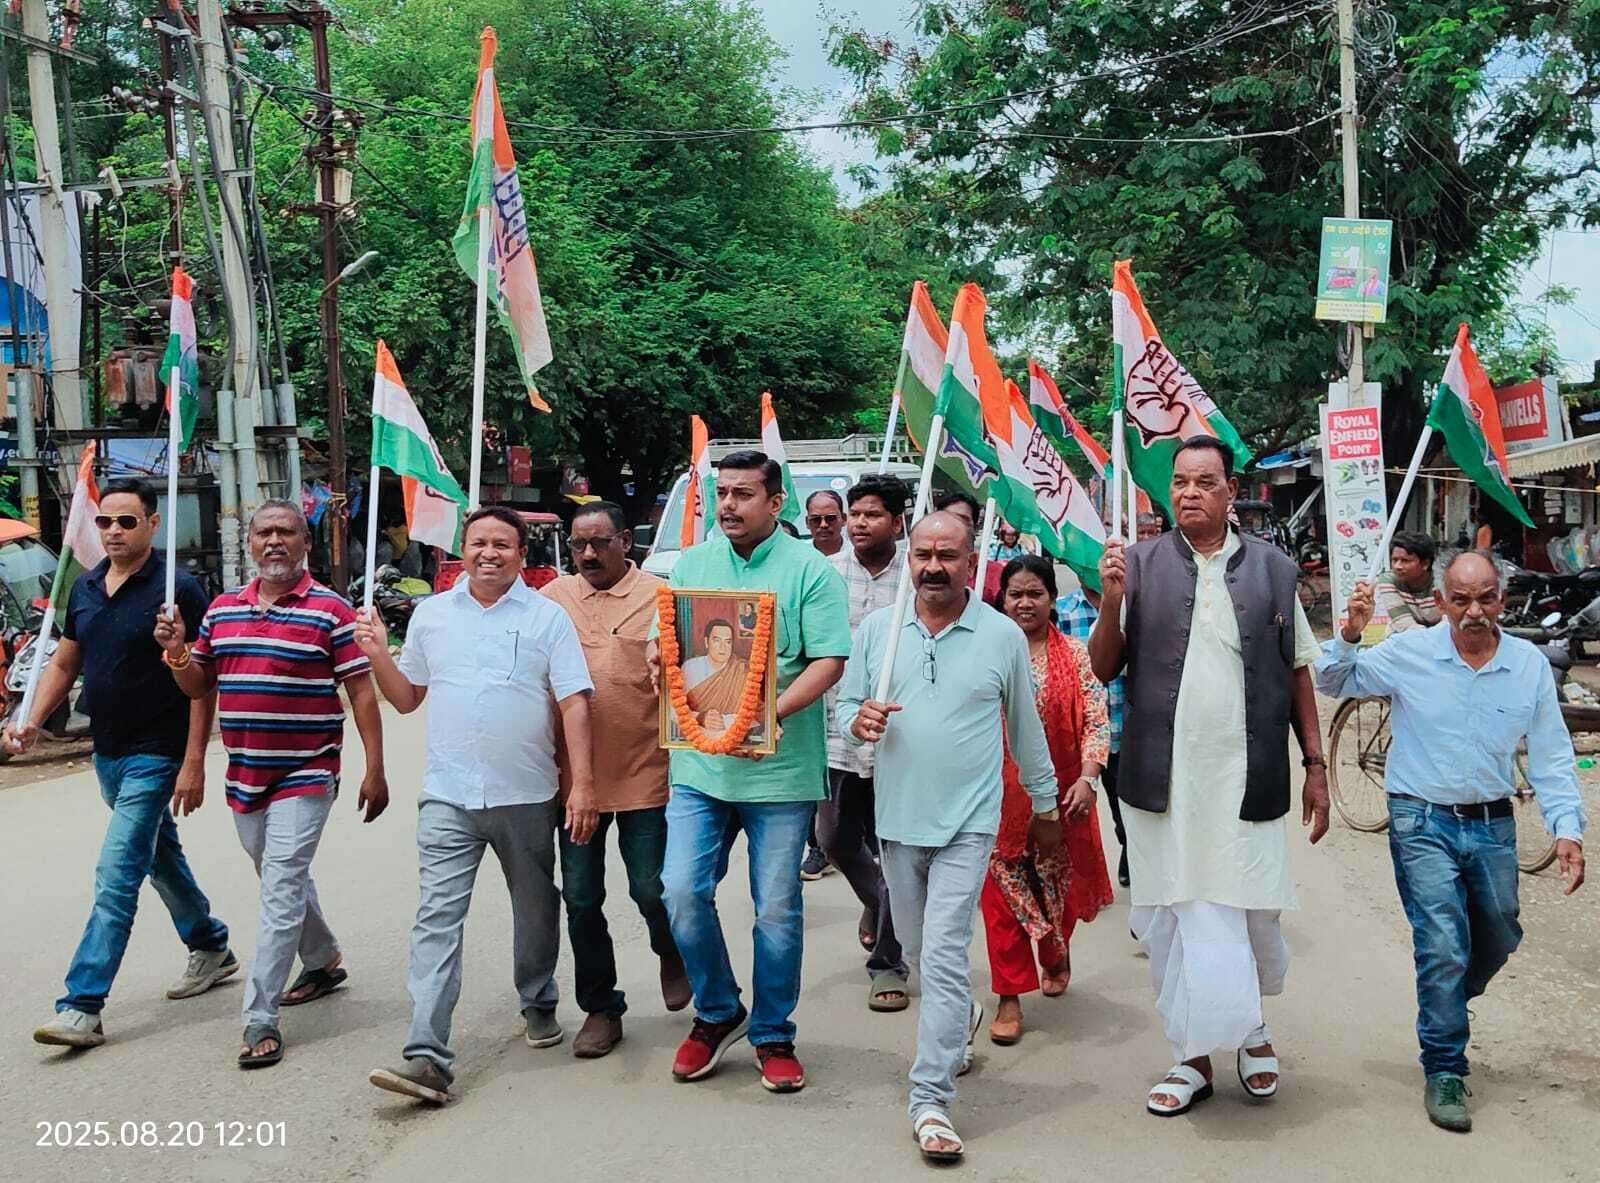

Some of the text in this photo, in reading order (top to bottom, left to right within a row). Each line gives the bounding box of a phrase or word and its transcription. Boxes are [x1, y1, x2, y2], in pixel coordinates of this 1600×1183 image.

[1333, 415, 1373, 429] ROYAL
[1329, 427, 1378, 445] ENFIELD
[1337, 444, 1372, 456] POINT
